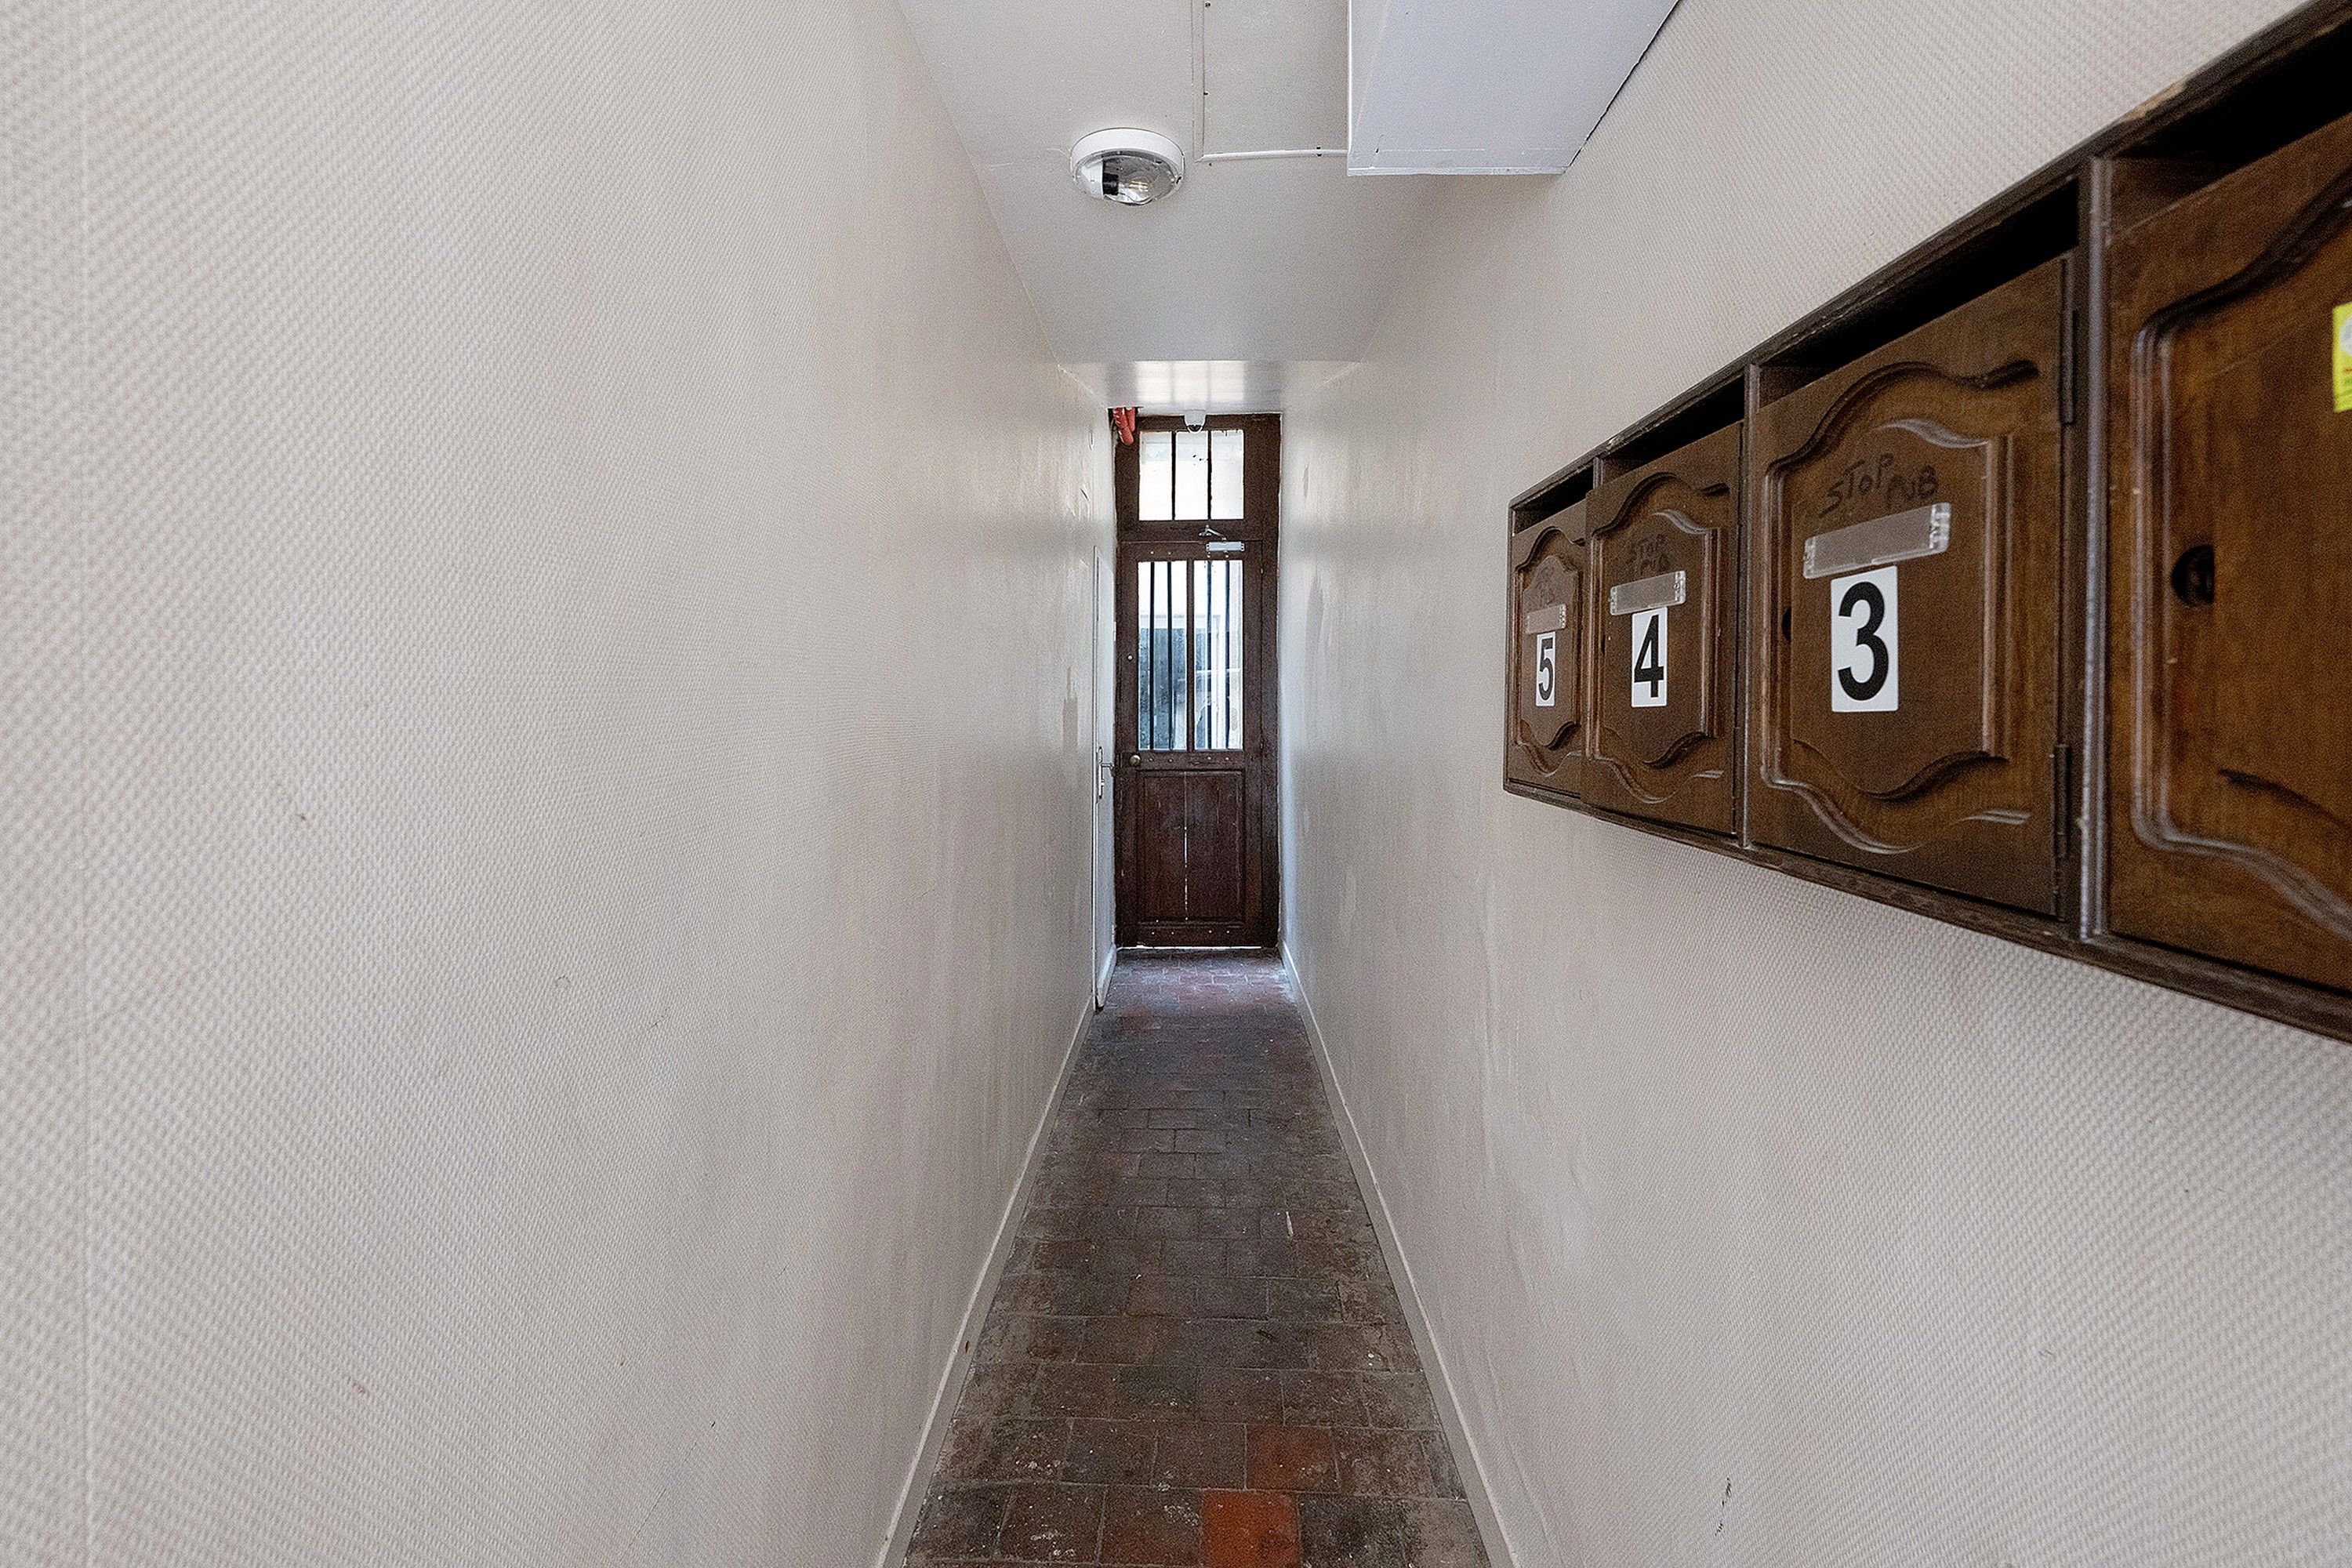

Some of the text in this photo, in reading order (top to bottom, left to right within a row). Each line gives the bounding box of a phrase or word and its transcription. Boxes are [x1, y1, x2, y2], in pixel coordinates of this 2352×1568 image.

[1538, 637, 1554, 701] 5
[1634, 614, 1664, 698] 4
[1838, 581, 1889, 702] 3
